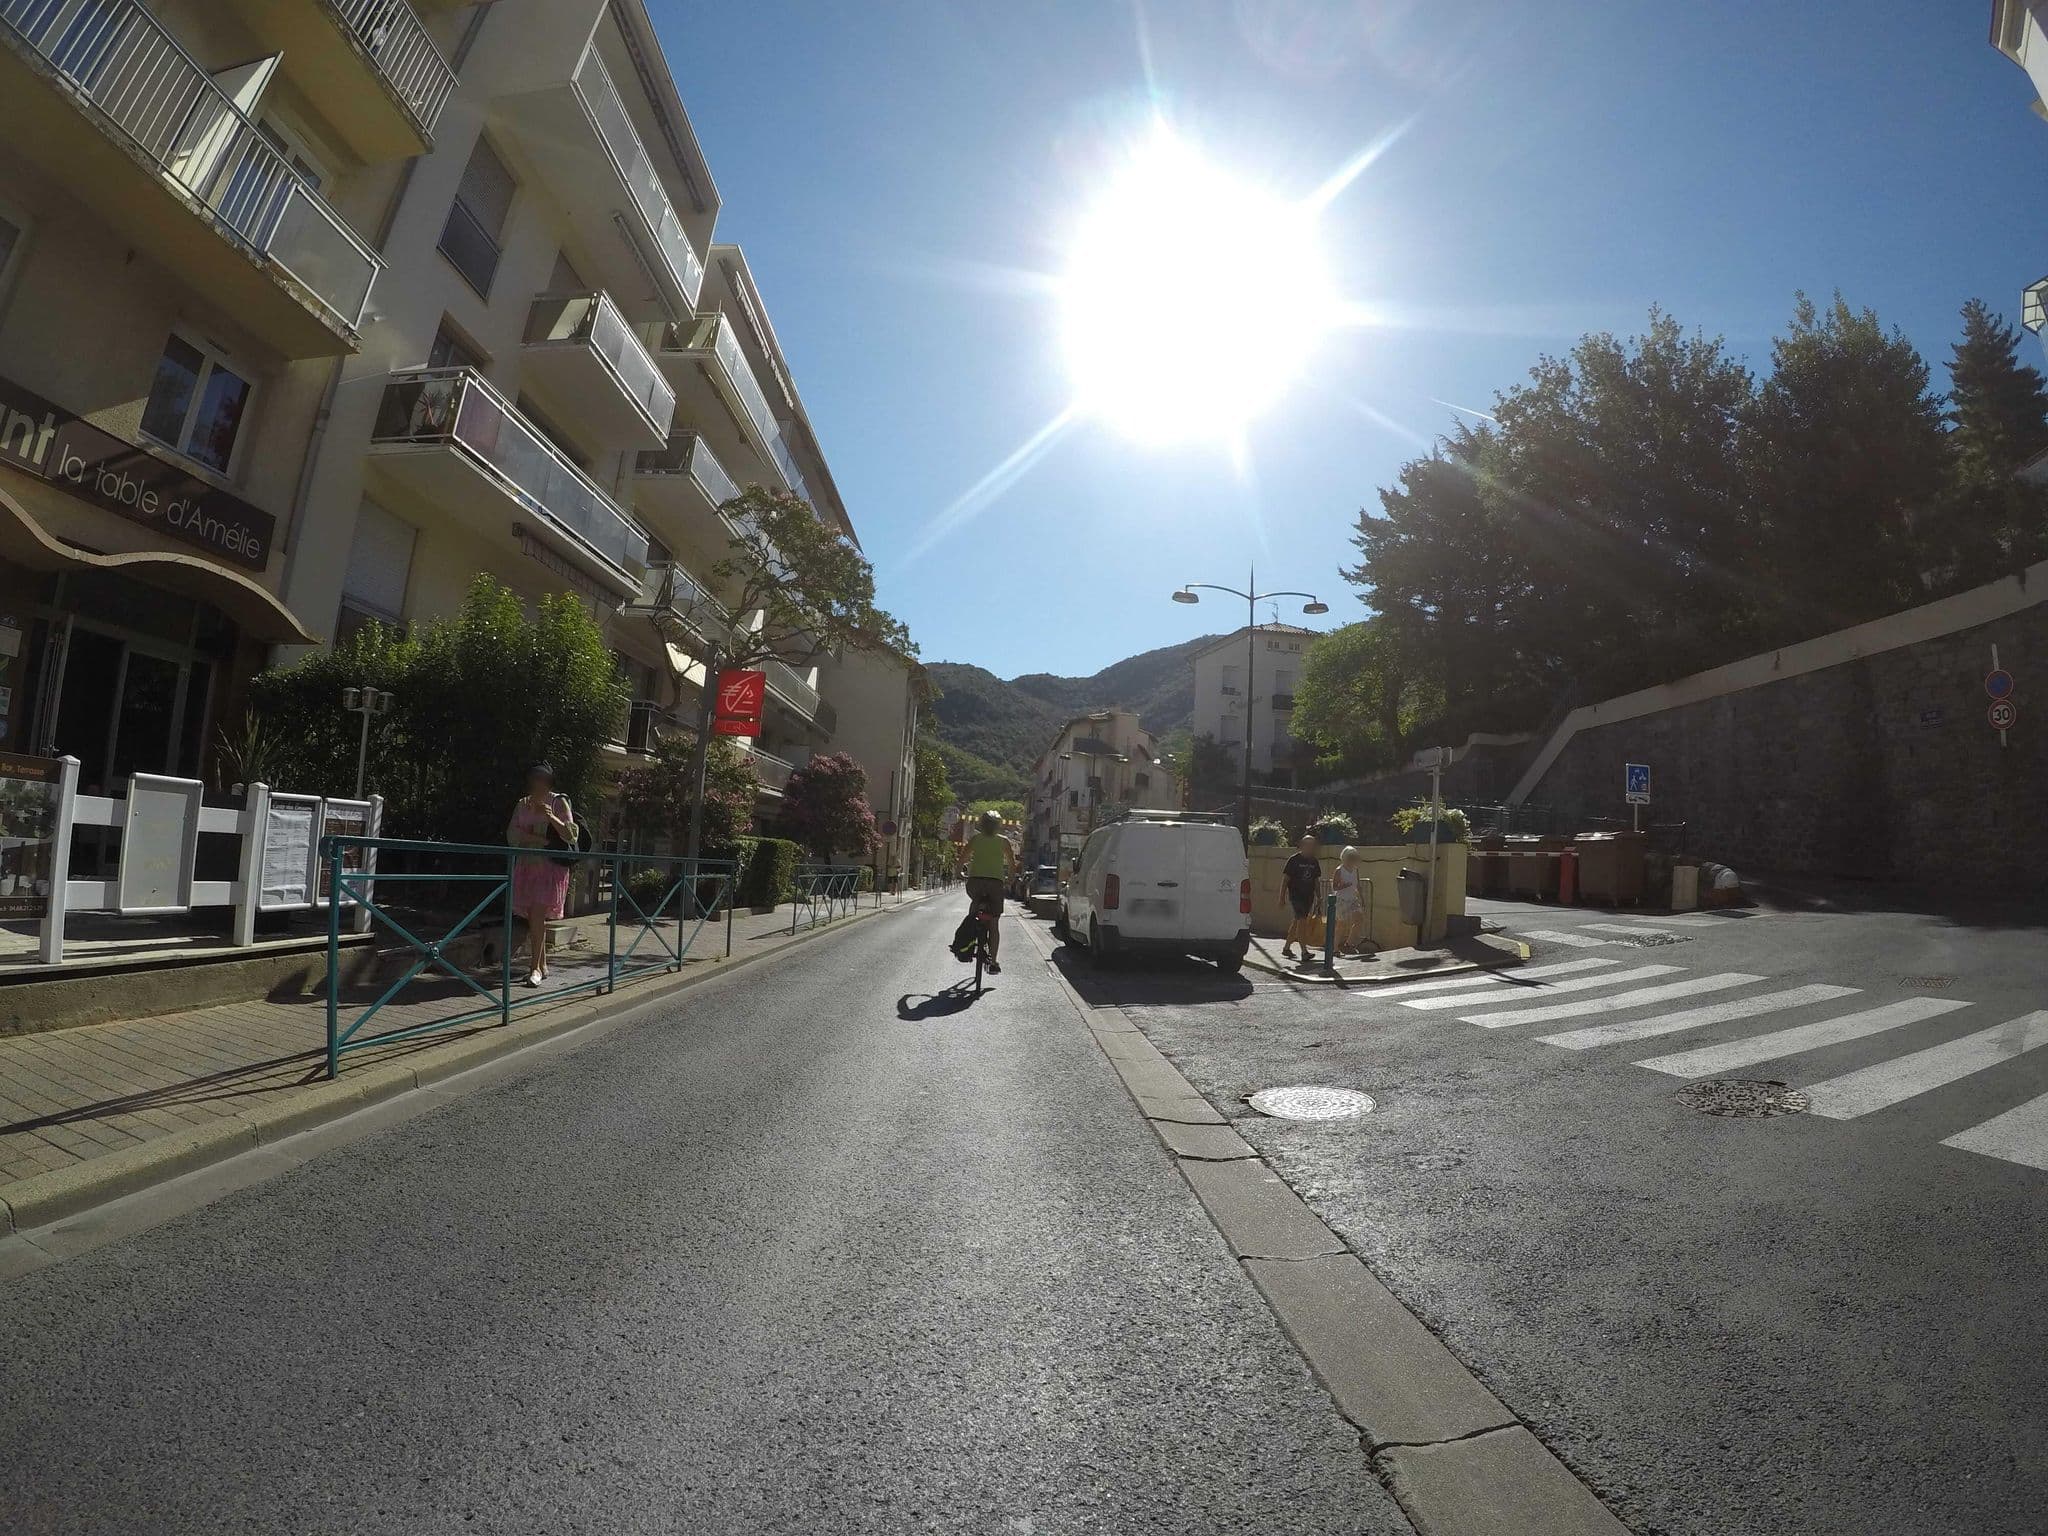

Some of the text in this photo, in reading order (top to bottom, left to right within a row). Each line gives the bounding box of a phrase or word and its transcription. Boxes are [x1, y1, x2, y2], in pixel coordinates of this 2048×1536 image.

[59, 443, 261, 559] la table d'Amélie
[1994, 708, 2010, 721] 30
